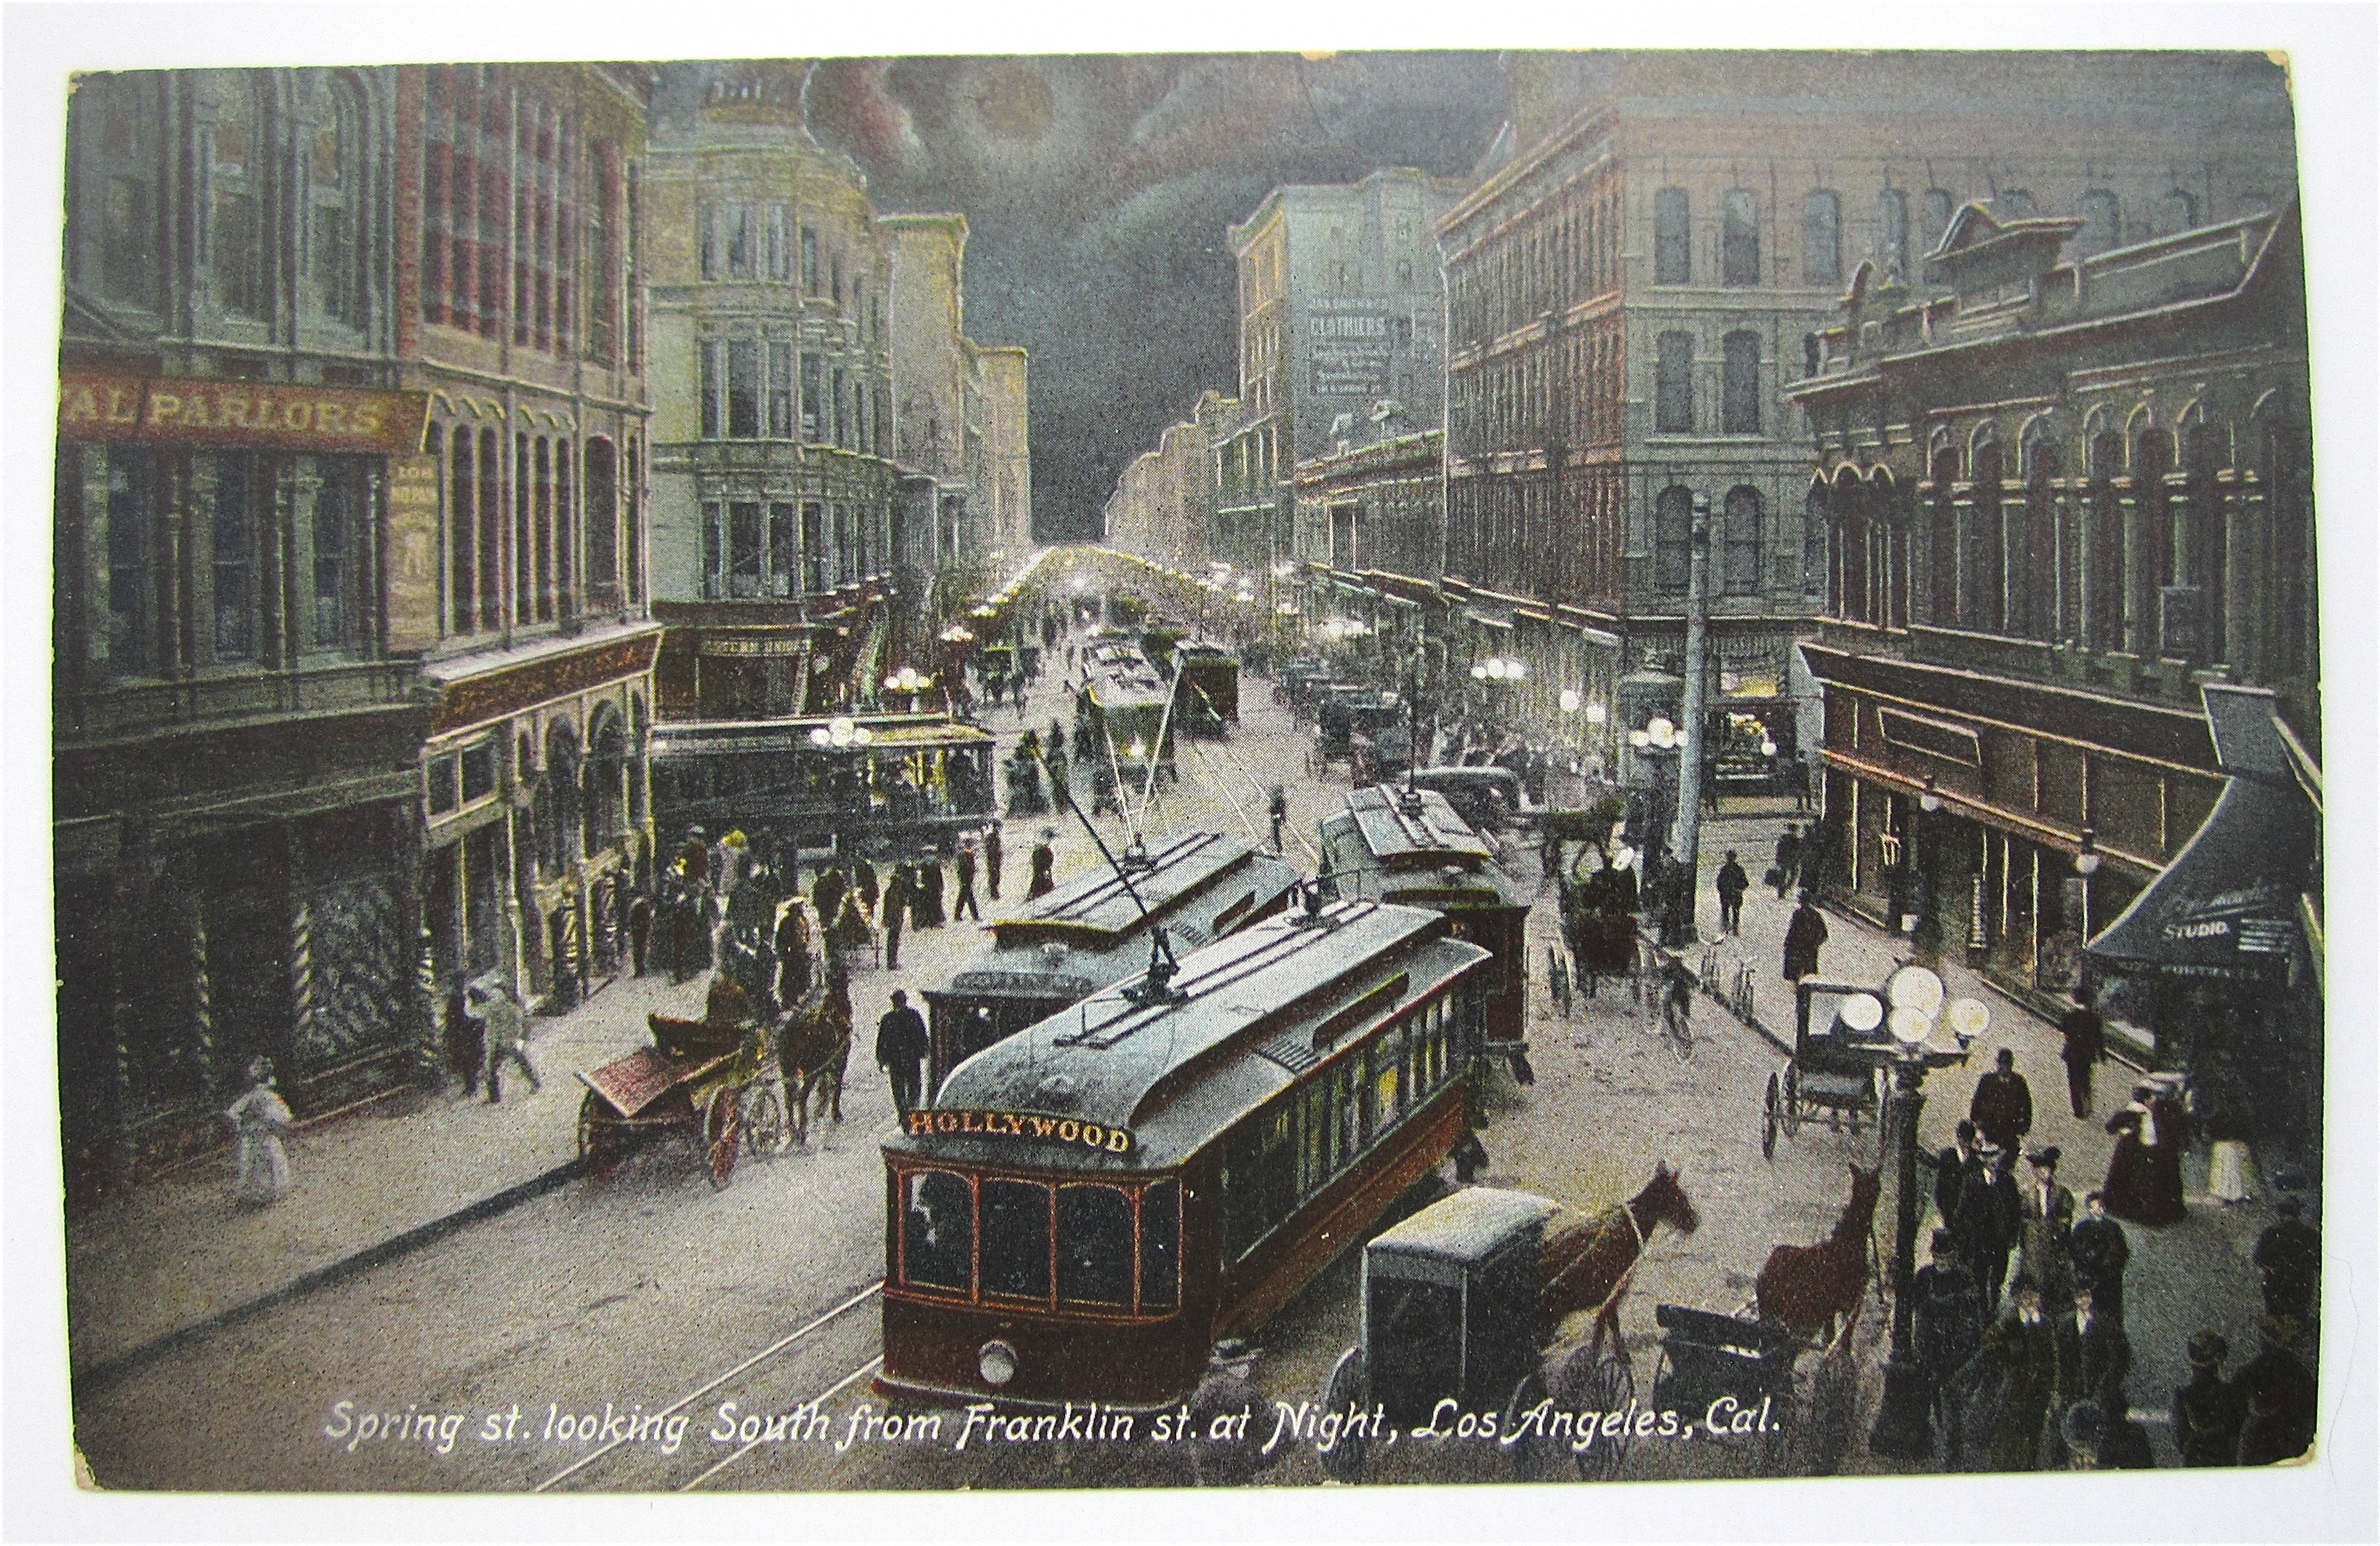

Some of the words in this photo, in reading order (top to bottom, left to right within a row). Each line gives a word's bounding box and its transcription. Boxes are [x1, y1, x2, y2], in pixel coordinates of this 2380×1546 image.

[1310, 317, 1387, 336] CLOTHIERS
[151, 393, 382, 434] PARLORS
[907, 1110, 1129, 1152] HOLLYWOOD
